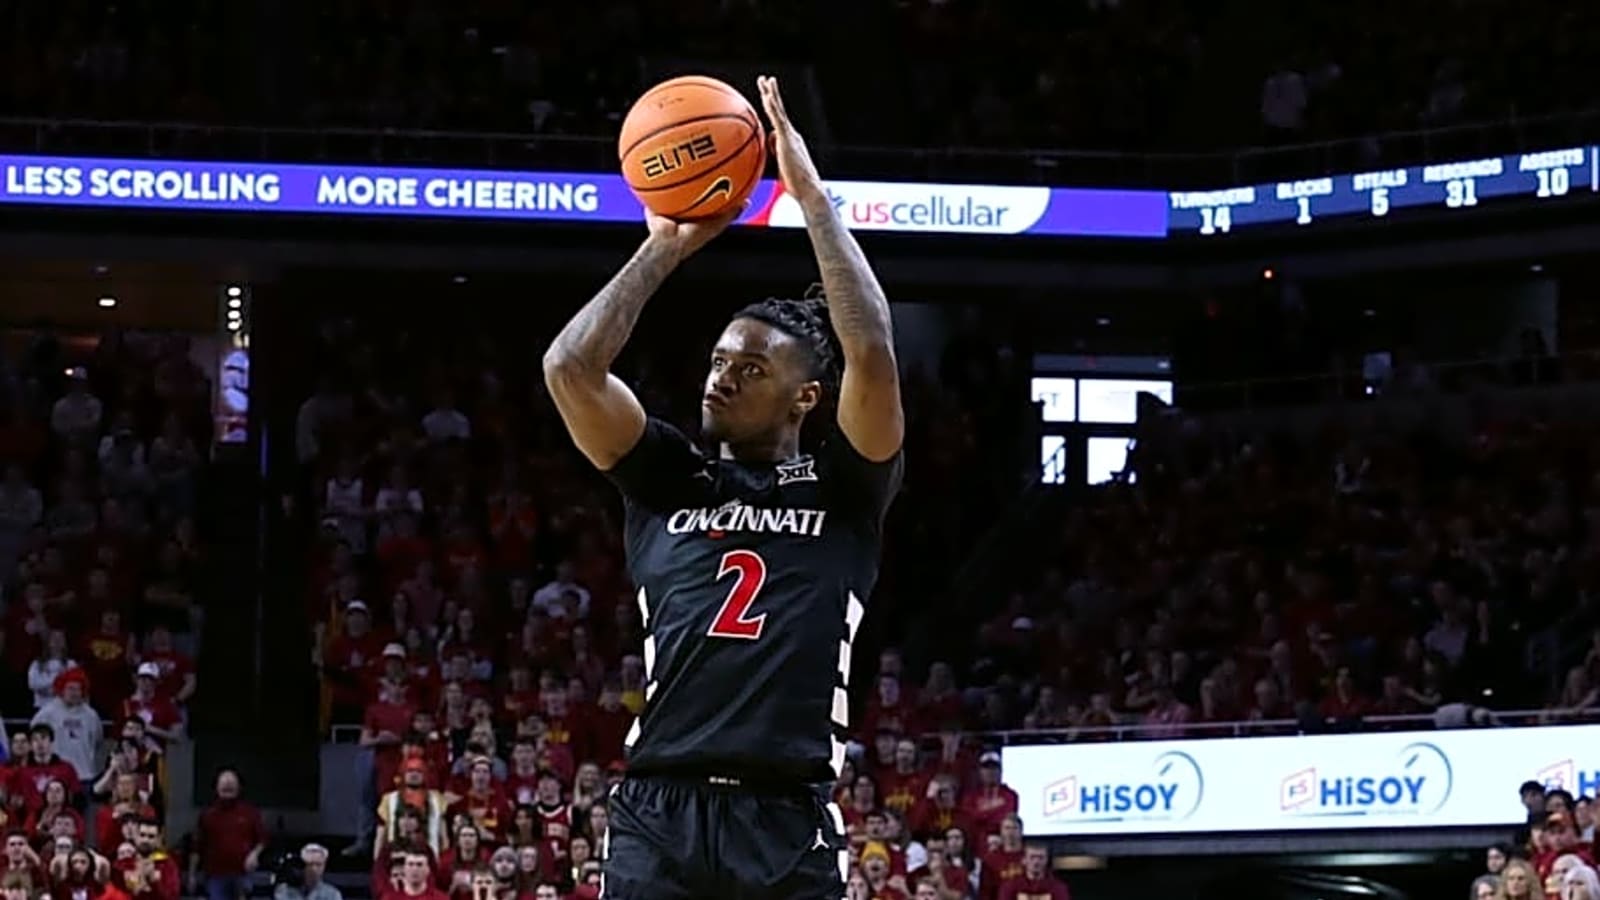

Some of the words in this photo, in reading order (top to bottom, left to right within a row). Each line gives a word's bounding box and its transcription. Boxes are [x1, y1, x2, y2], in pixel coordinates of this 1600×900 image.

[642, 134, 717, 178] ELITE
[6, 165, 83, 196] LESS
[89, 168, 280, 202] SCROLLING
[317, 175, 418, 206] MORE
[423, 178, 599, 212] CHEERING
[1353, 168, 1407, 191] STEALS
[1446, 178, 1478, 208] 31
[1537, 167, 1569, 198] 10
[852, 196, 1009, 227] uscellular
[1297, 197, 1312, 225] 1
[1371, 188, 1389, 216] 5
[1200, 206, 1231, 235] 14
[666, 502, 827, 538] CINCINNATI
[706, 549, 768, 640] 2
[1080, 783, 1179, 813] HiSOY
[1320, 776, 1427, 806] HiSOY
